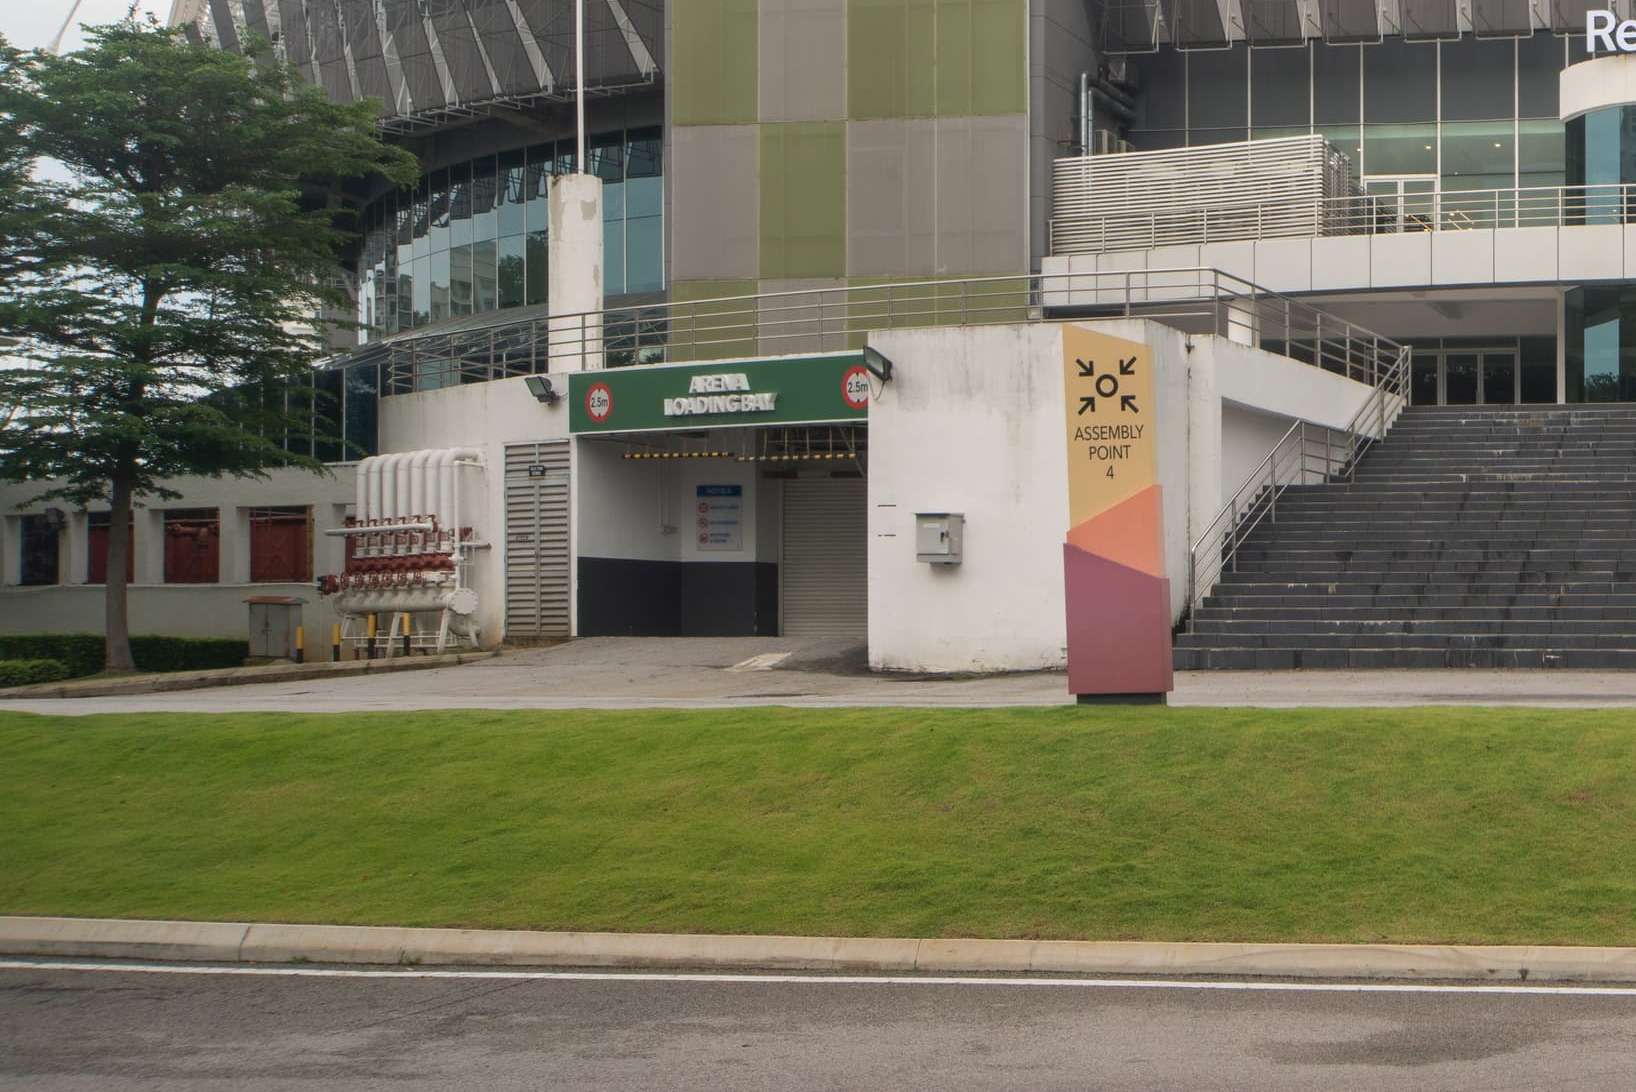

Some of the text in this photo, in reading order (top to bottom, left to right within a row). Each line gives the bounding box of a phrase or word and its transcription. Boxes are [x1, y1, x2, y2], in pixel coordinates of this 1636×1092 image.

[688, 373, 750, 394] ARENA
[847, 381, 868, 394] 2.5m
[591, 396, 609, 408] 2.5m
[664, 393, 777, 416] LOADING BAY
[1074, 424, 1144, 441] ASSEMBLY
[1089, 445, 1131, 460] POINT
[1106, 465, 1114, 479] 4
